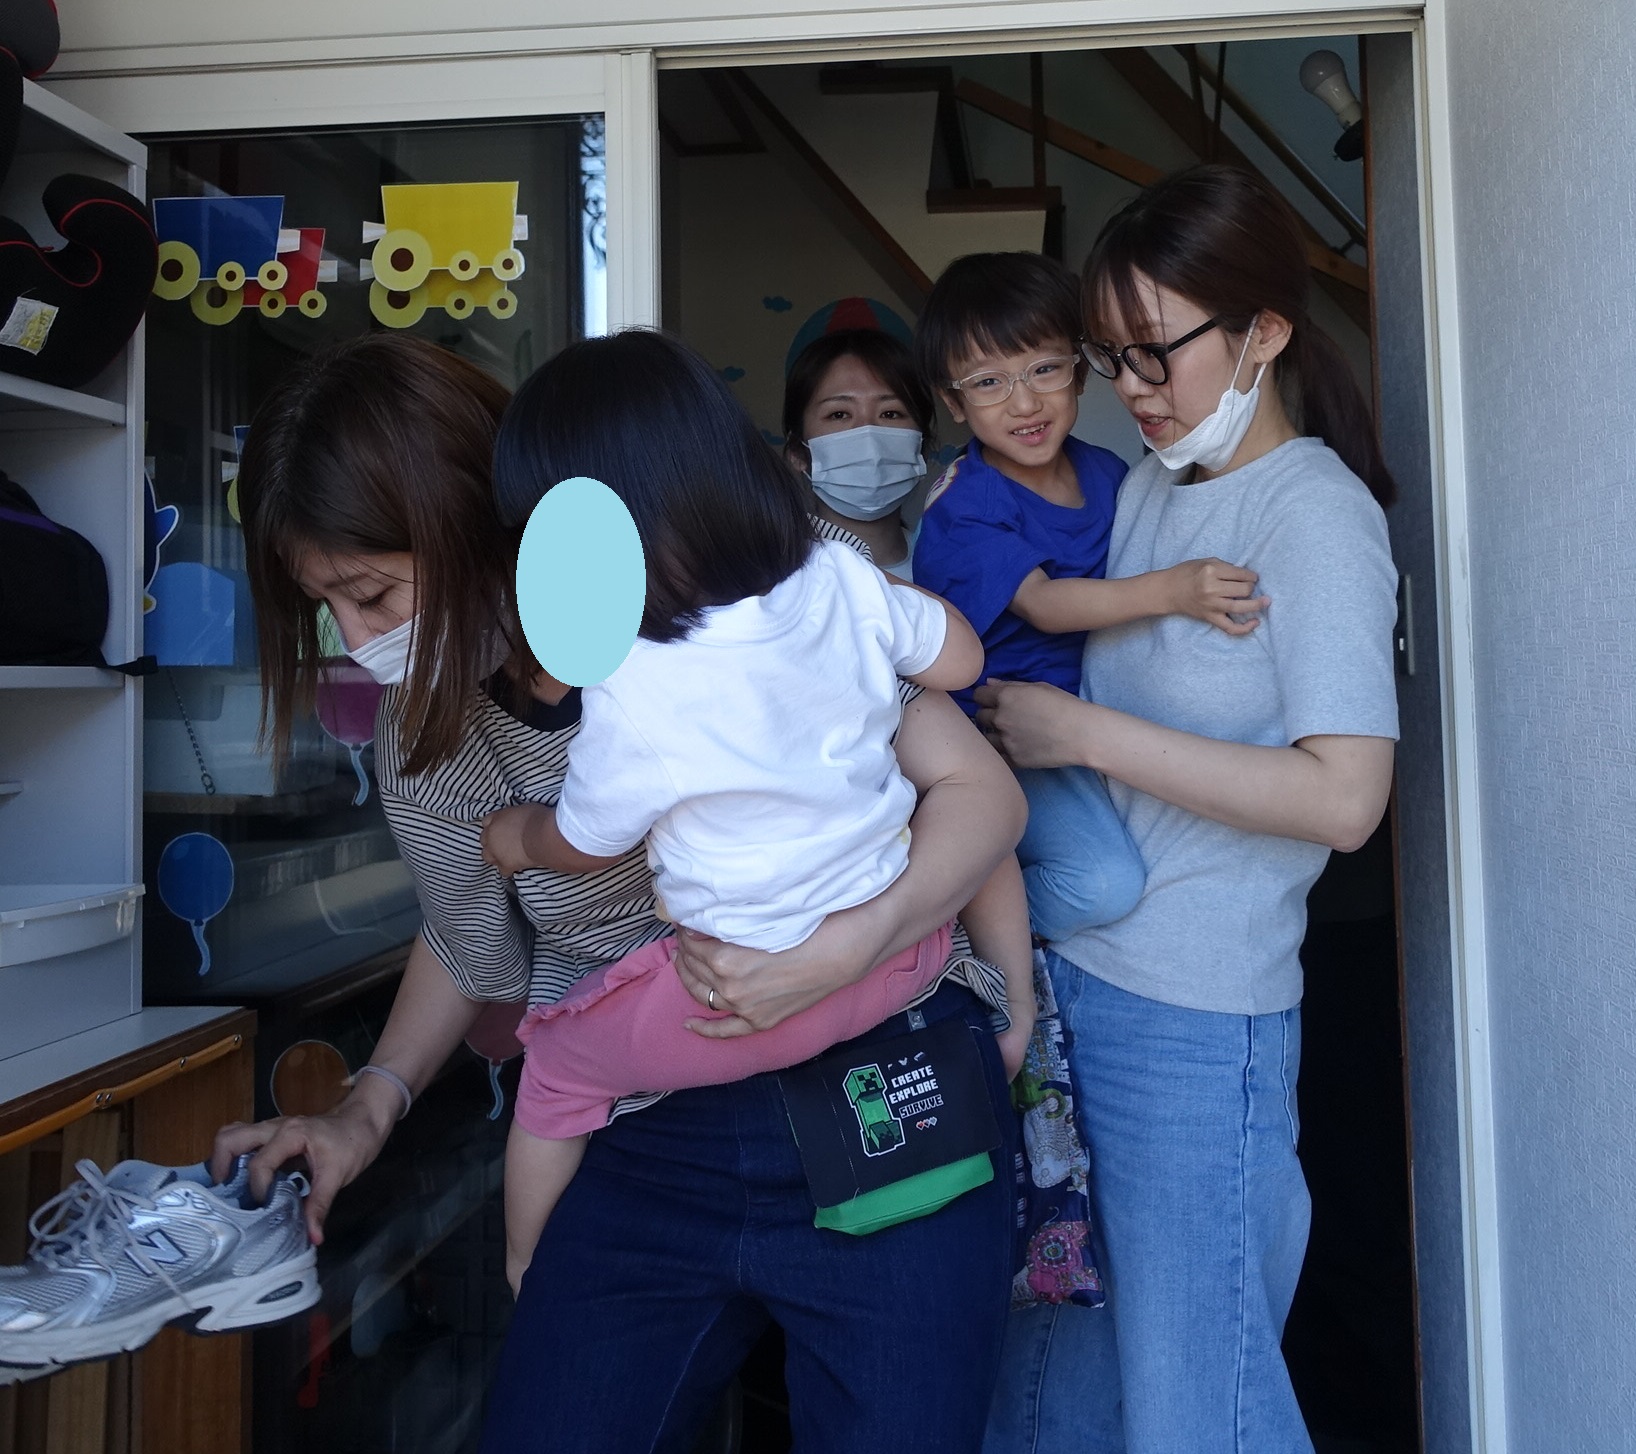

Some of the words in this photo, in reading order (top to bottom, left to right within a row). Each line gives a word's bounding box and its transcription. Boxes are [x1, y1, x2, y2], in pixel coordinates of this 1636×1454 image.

[891, 1065, 934, 1088] CREATE
[889, 1079, 938, 1104] EXPLORE
[899, 1095, 944, 1118] SURVIVE
